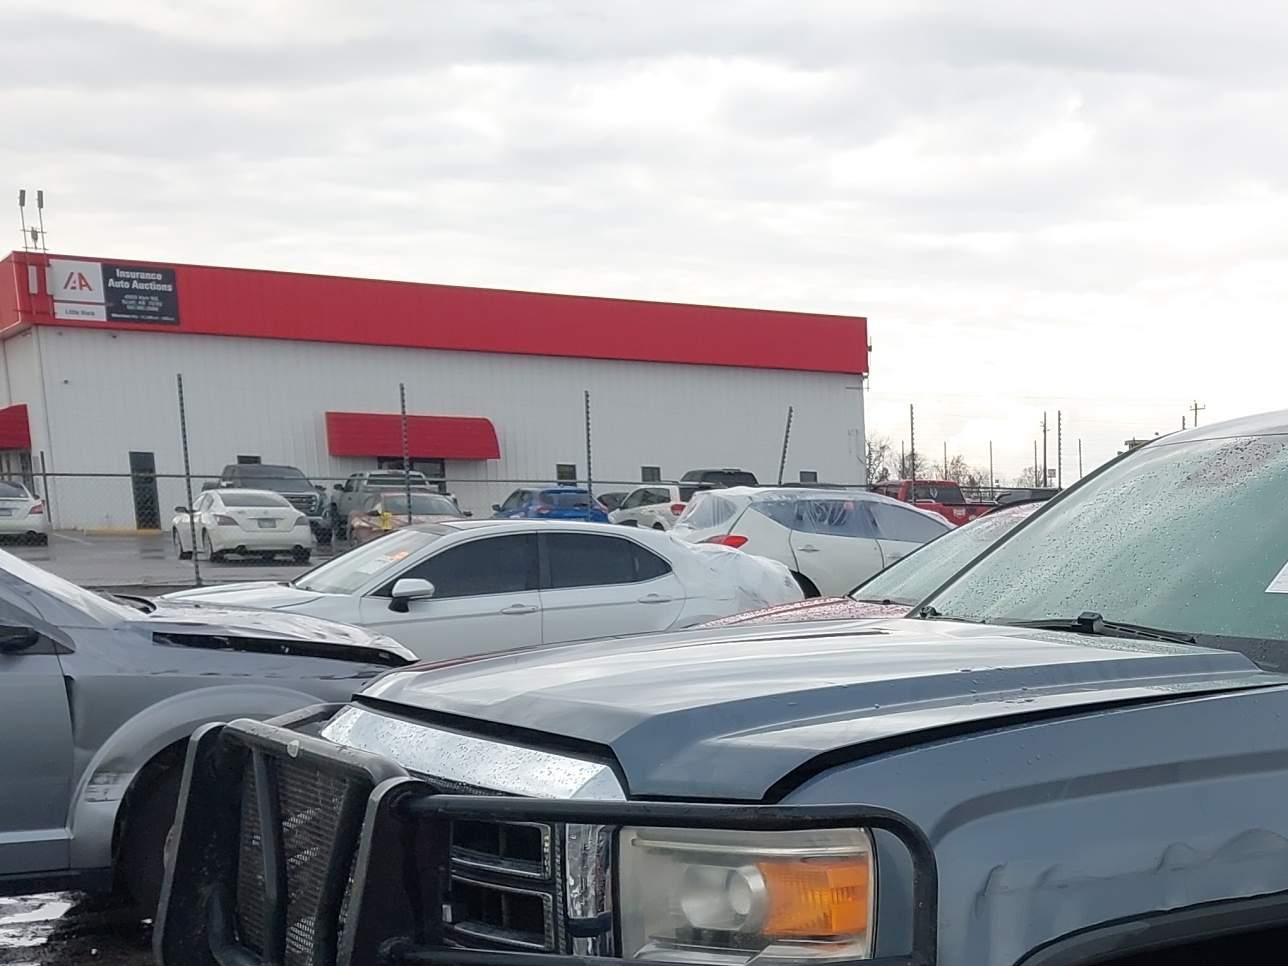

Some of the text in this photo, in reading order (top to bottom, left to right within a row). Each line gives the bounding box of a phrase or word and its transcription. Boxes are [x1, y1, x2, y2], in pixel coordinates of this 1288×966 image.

[116, 268, 162, 280] Insurance
[108, 278, 173, 292] Auto Auctions
